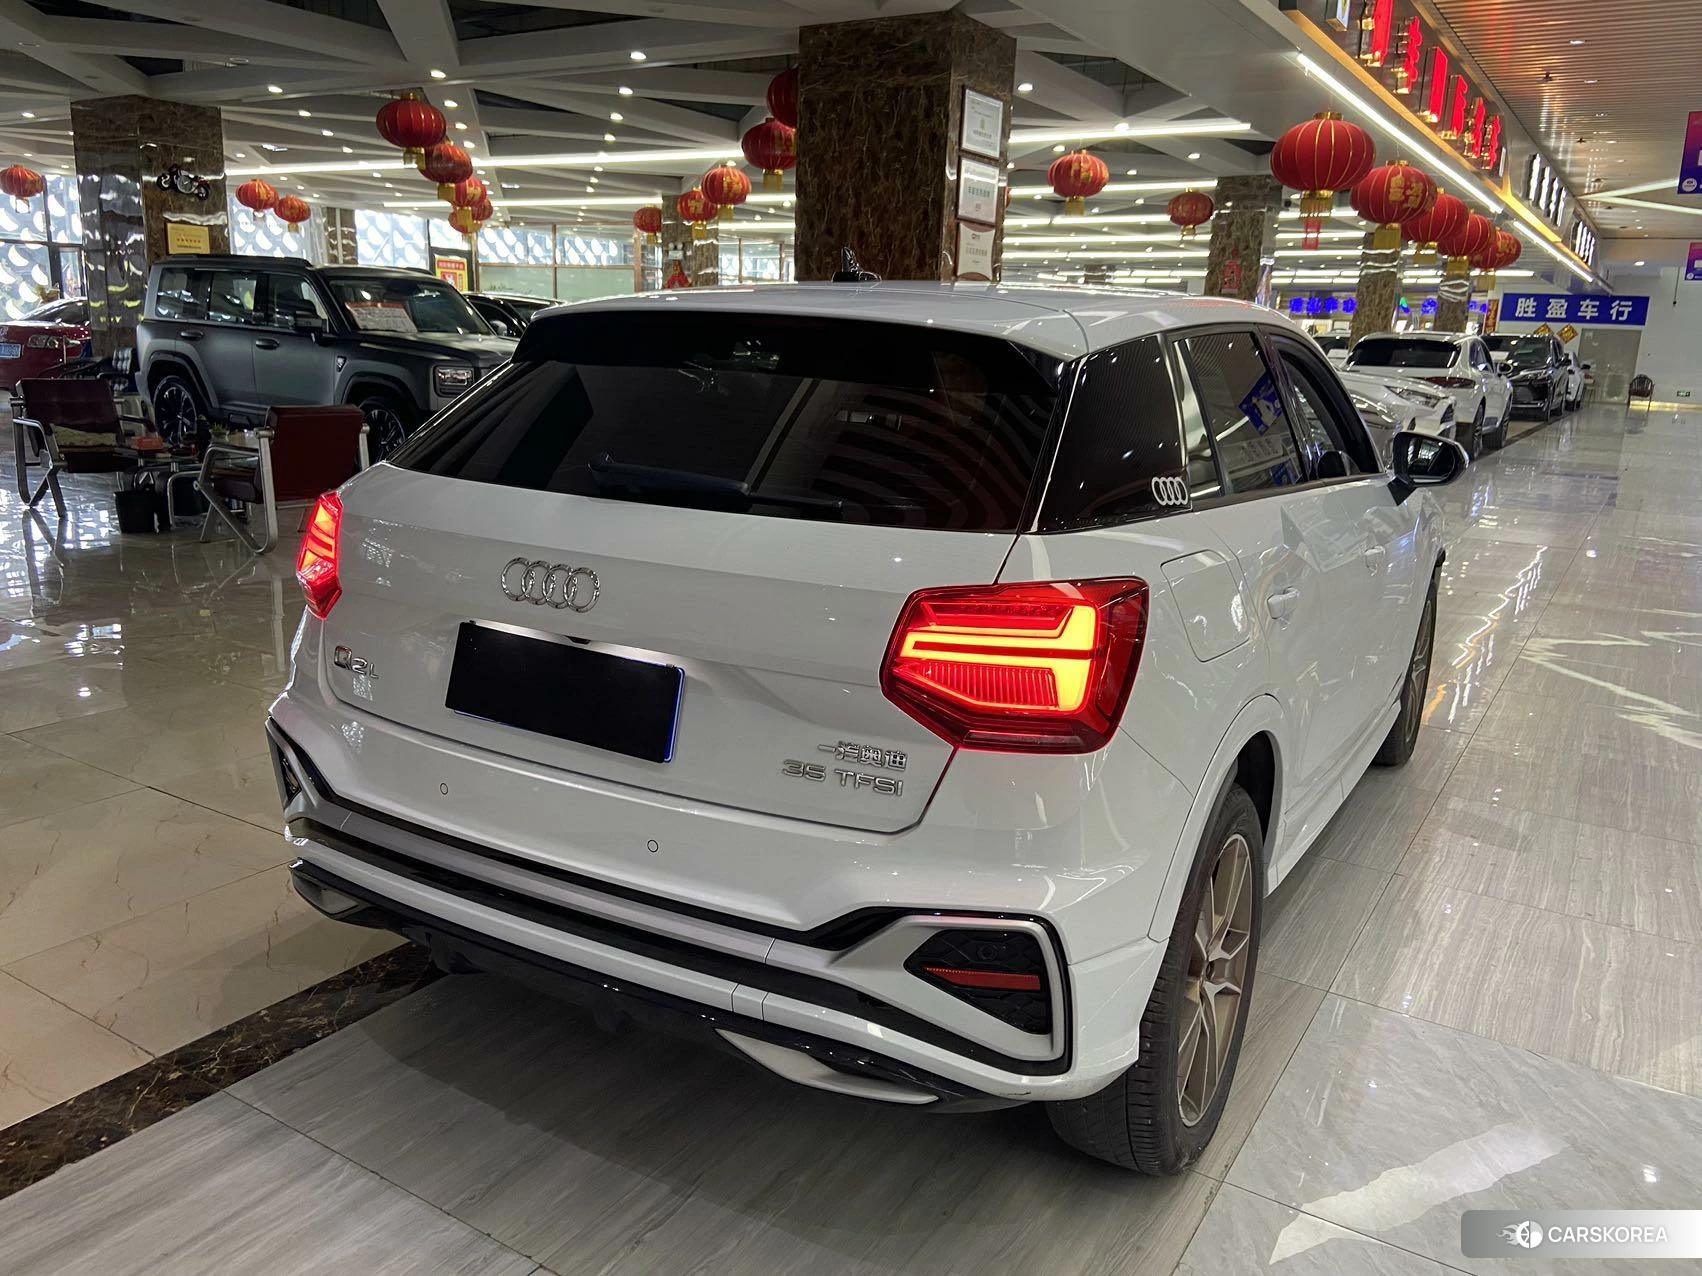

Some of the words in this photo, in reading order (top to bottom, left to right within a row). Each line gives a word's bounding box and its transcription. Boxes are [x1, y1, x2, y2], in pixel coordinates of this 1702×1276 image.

[1515, 297, 1632, 321] 胜盈车行
[334, 646, 379, 679] Q2L
[818, 741, 907, 771] 一汽奥迪
[782, 759, 826, 782] 35
[834, 768, 904, 797] TFSI
